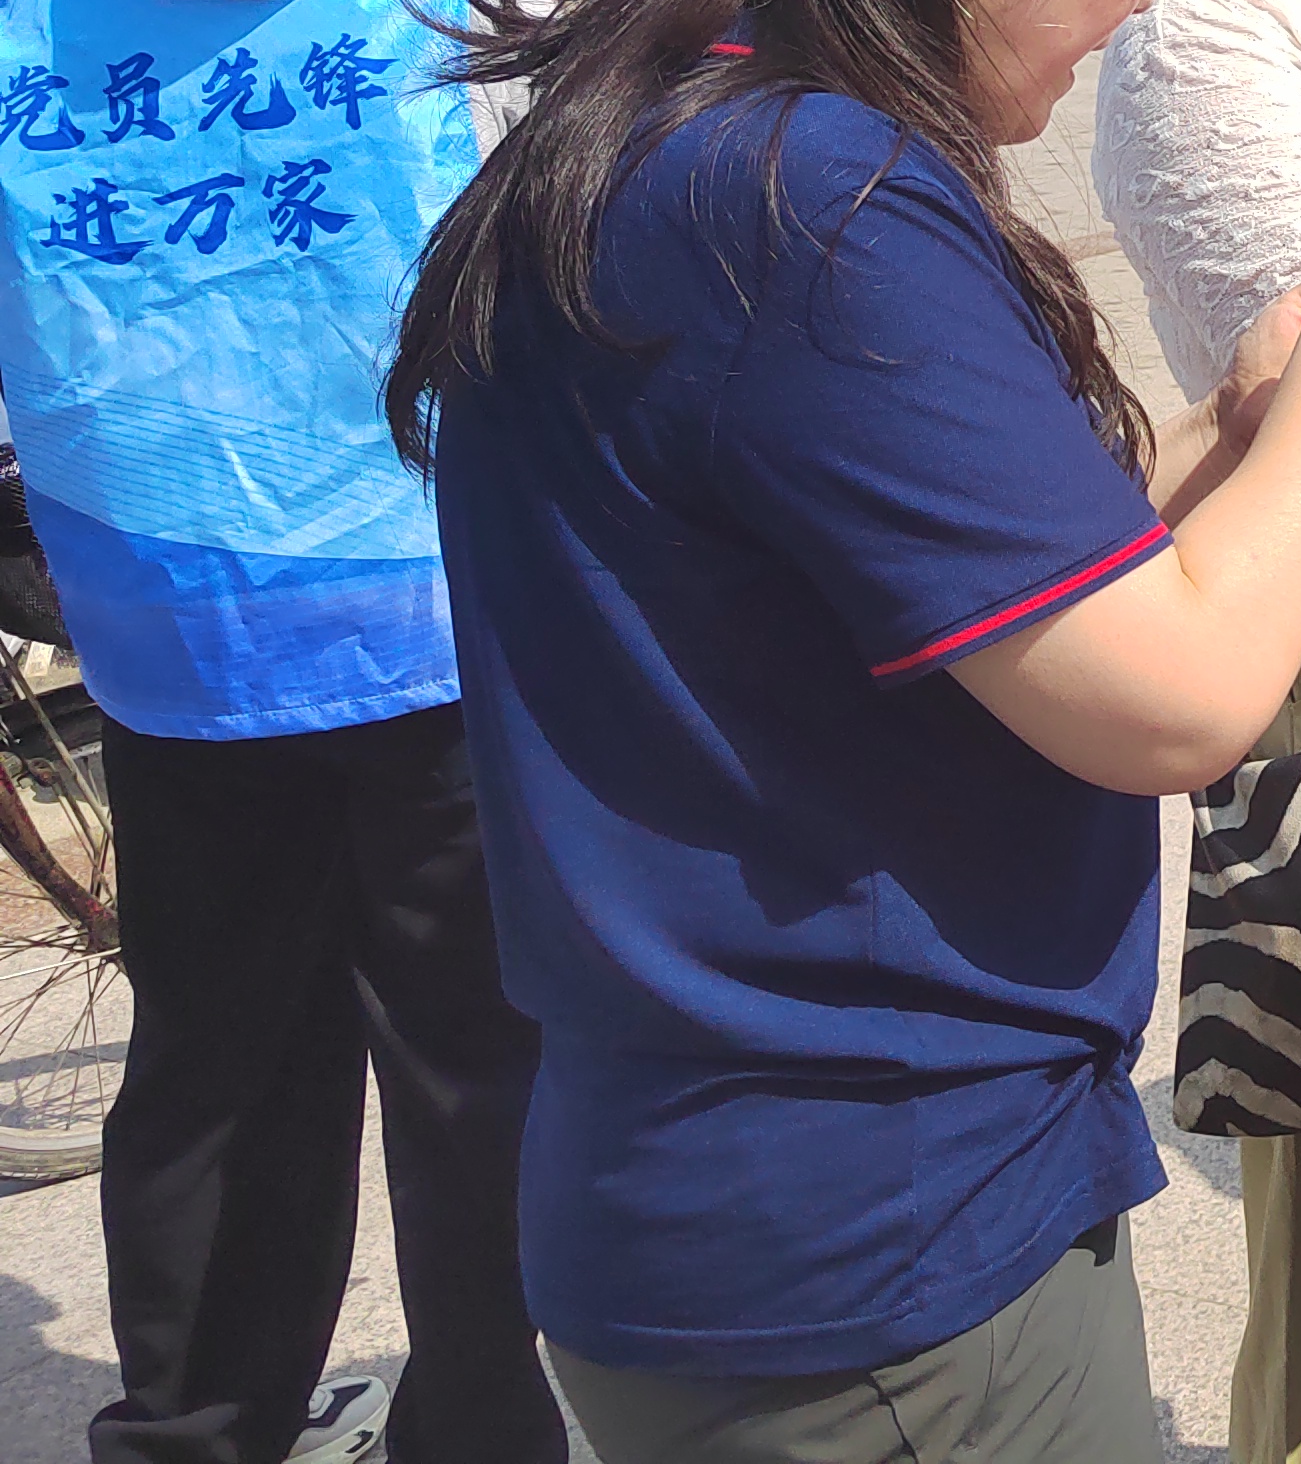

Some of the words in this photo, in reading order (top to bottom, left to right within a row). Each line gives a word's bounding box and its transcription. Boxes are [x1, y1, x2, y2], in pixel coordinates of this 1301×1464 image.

[0, 33, 398, 151] 党员先锋
[40, 158, 357, 265] 进万家
